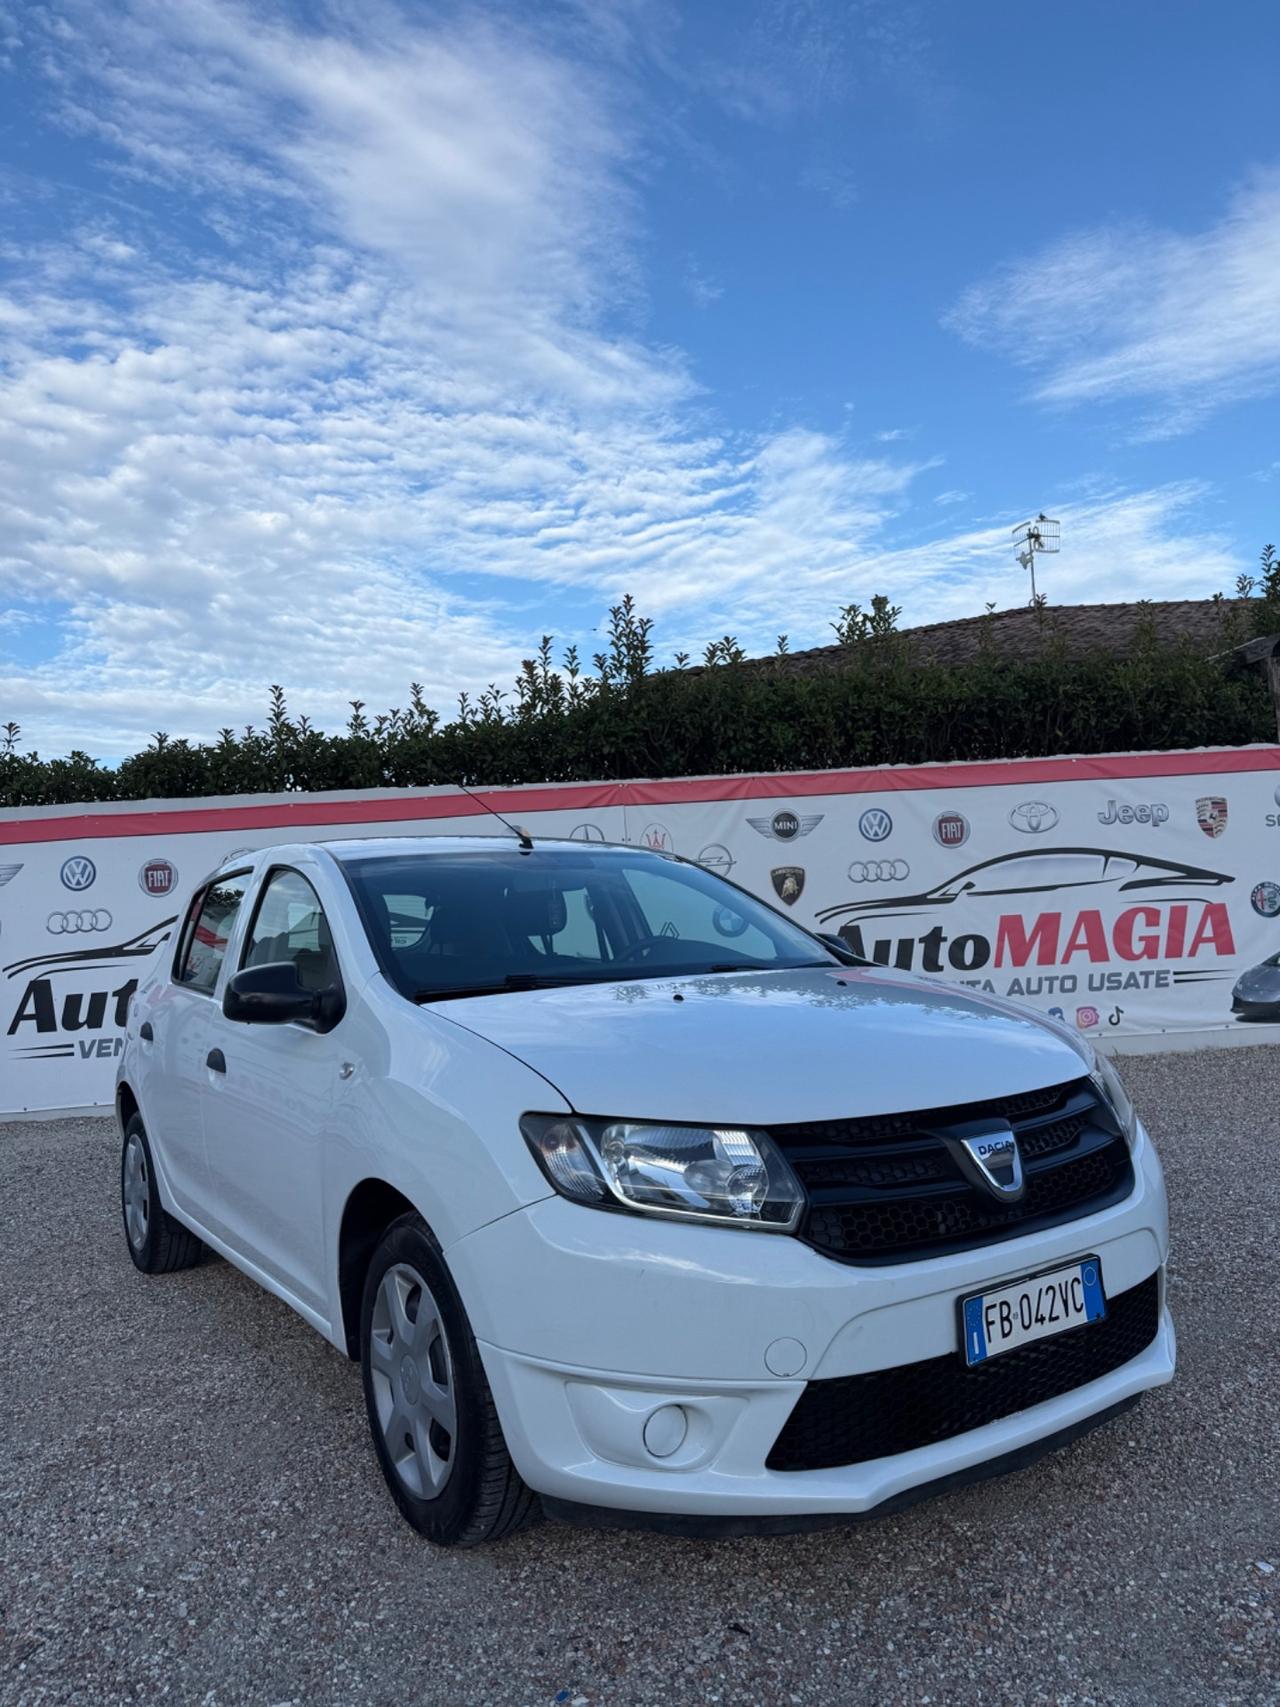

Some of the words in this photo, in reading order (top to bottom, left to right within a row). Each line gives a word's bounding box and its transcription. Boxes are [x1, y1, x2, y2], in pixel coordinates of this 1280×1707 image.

[1098, 800, 1170, 828] Jeep
[774, 820, 798, 831] MINI
[941, 821, 963, 840] FIAT
[147, 869, 171, 888] FIAT
[1006, 974, 1078, 997] AUTO
[1088, 969, 1172, 992] USATE
[977, 1140, 1015, 1156] DACIA
[985, 1300, 1013, 1344] FB
[1019, 1276, 1084, 1331] 042VC
